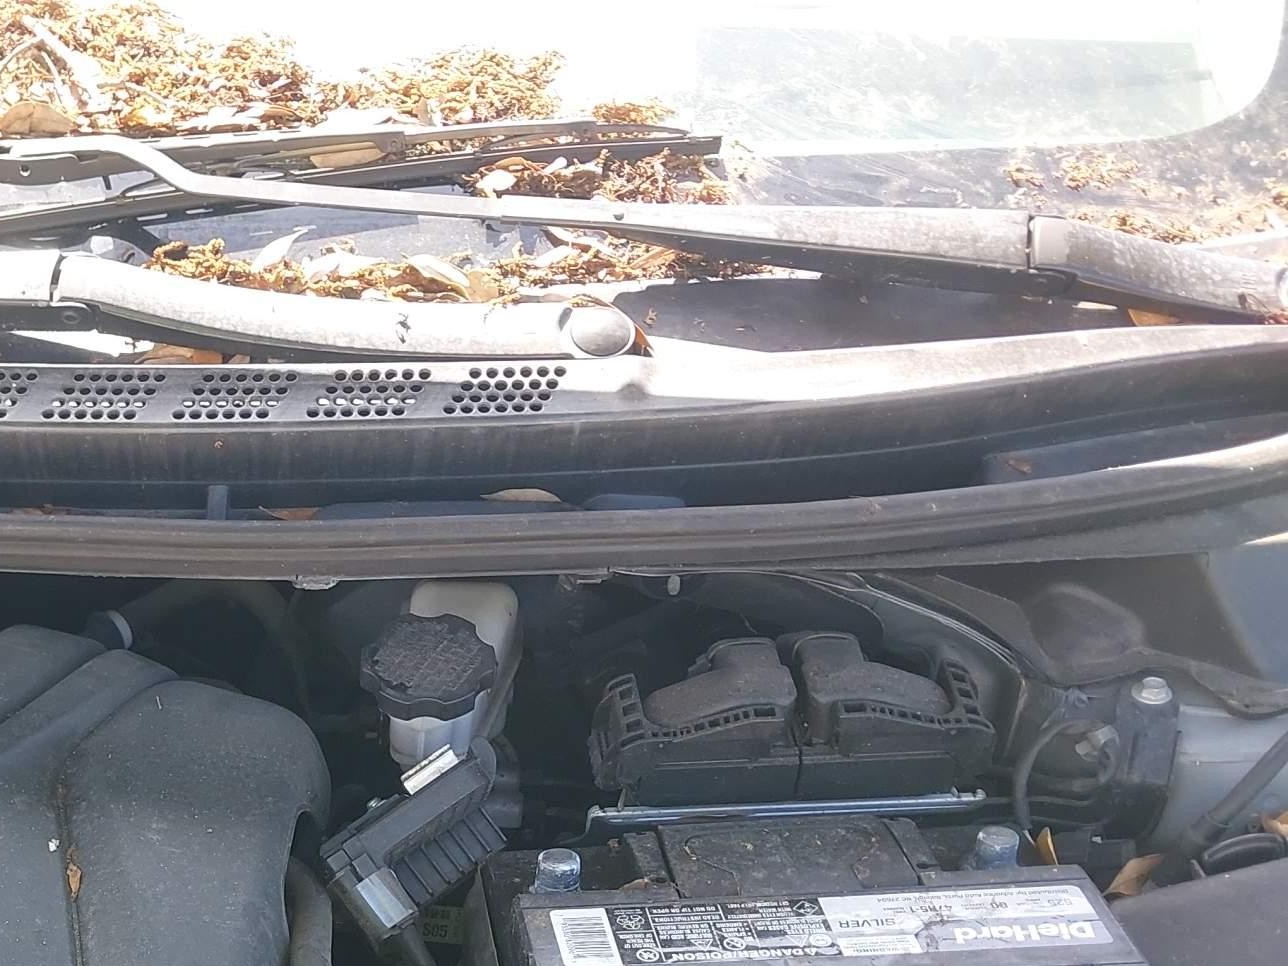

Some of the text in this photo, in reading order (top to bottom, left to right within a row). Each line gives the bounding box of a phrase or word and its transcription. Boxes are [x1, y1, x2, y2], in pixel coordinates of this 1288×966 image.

[838, 918, 895, 928] SILVER
[952, 922, 1095, 944] DieHard
[671, 949, 804, 962] DANGER/POISON
